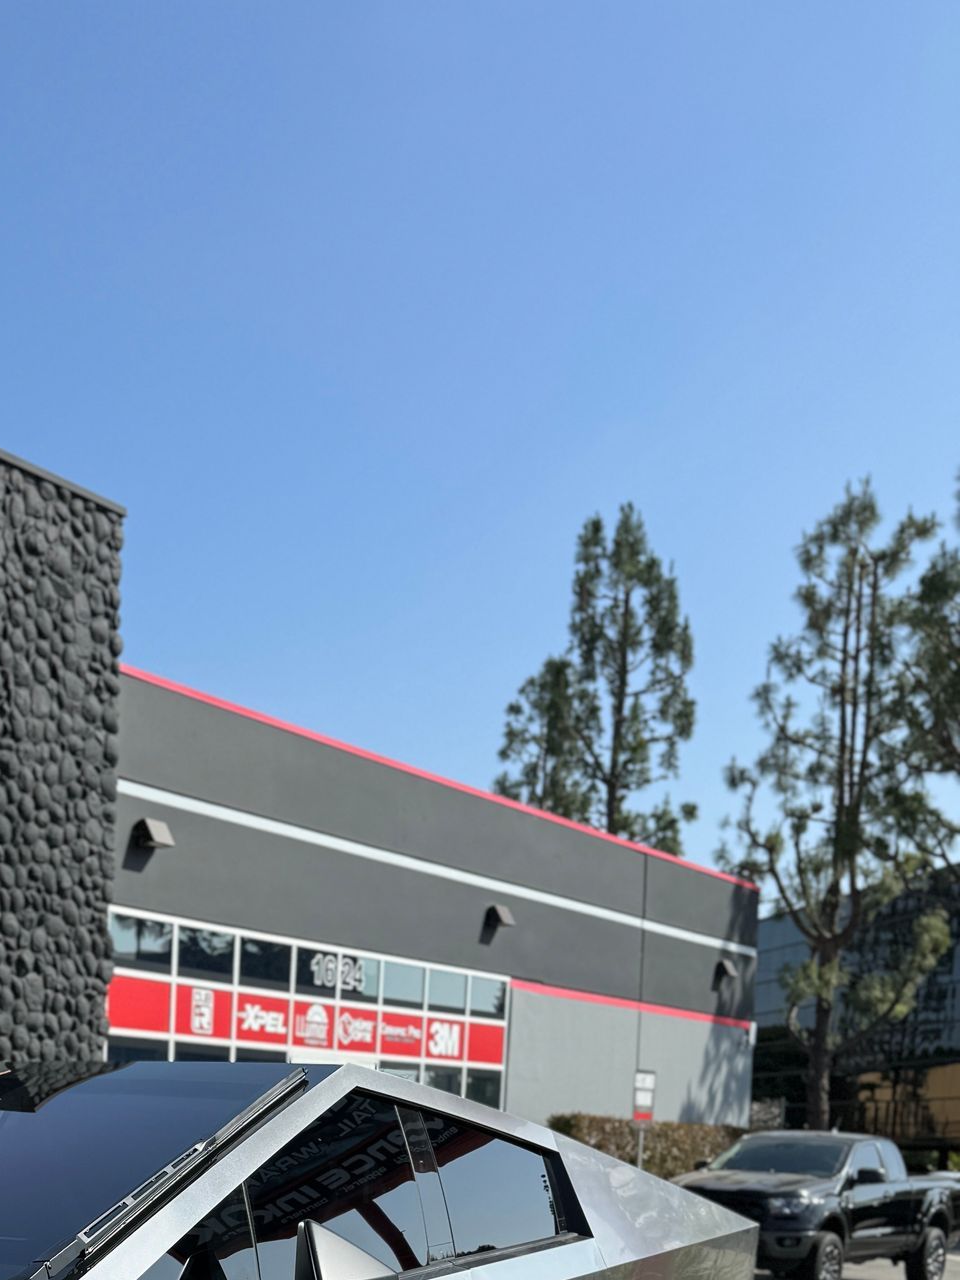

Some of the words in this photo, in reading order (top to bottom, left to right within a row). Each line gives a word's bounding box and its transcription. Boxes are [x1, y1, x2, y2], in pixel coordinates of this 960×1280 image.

[309, 953, 366, 992] 1624
[240, 1003, 288, 1035] XPEL
[429, 1022, 460, 1058] 3M
